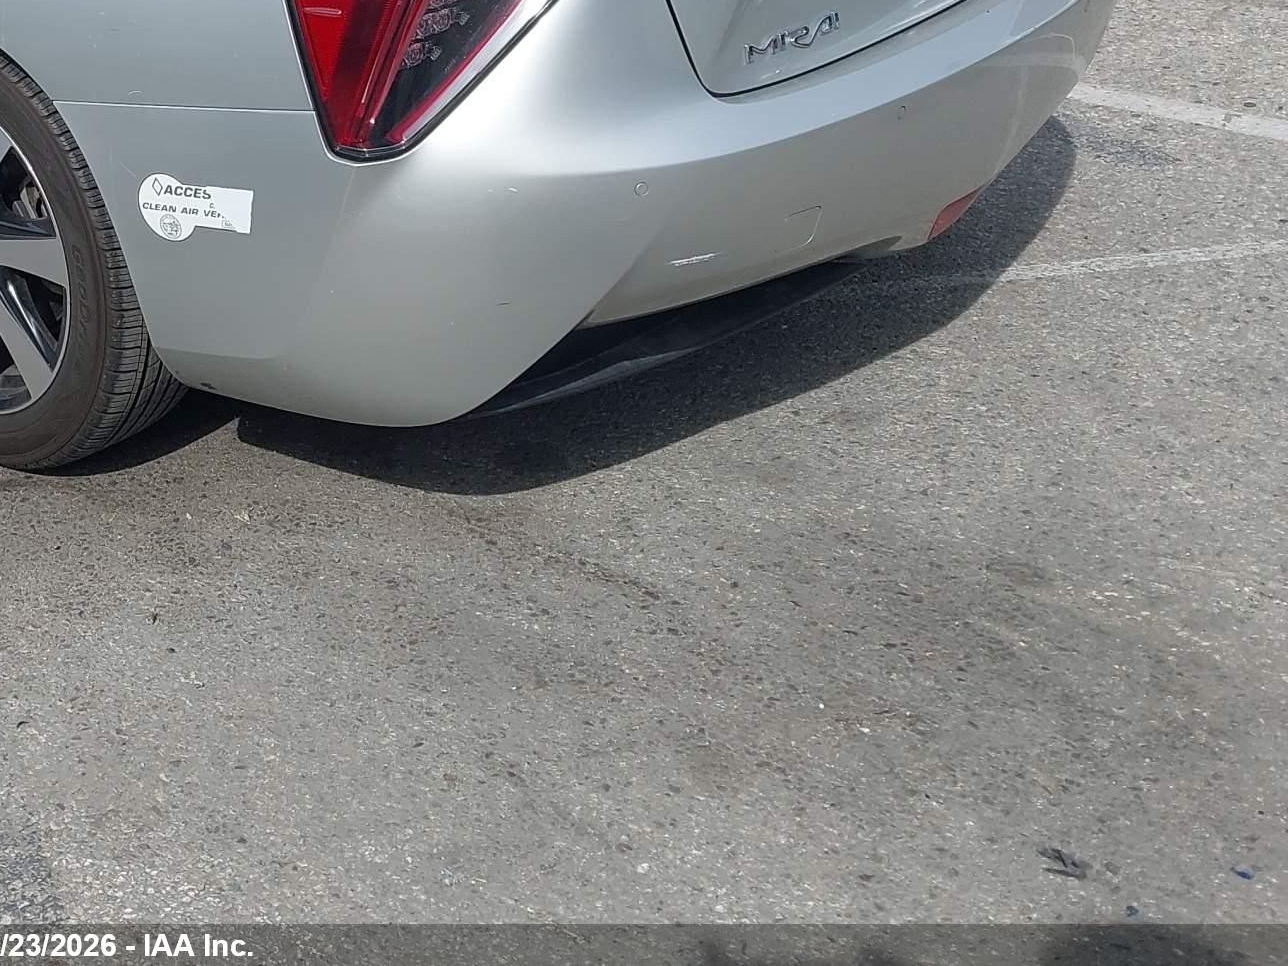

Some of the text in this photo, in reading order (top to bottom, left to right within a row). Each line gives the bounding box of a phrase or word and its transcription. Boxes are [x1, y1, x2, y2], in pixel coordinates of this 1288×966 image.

[743, 11, 840, 64] MIRAI
[142, 202, 177, 213] CLEAN
[181, 207, 199, 216] AIR
